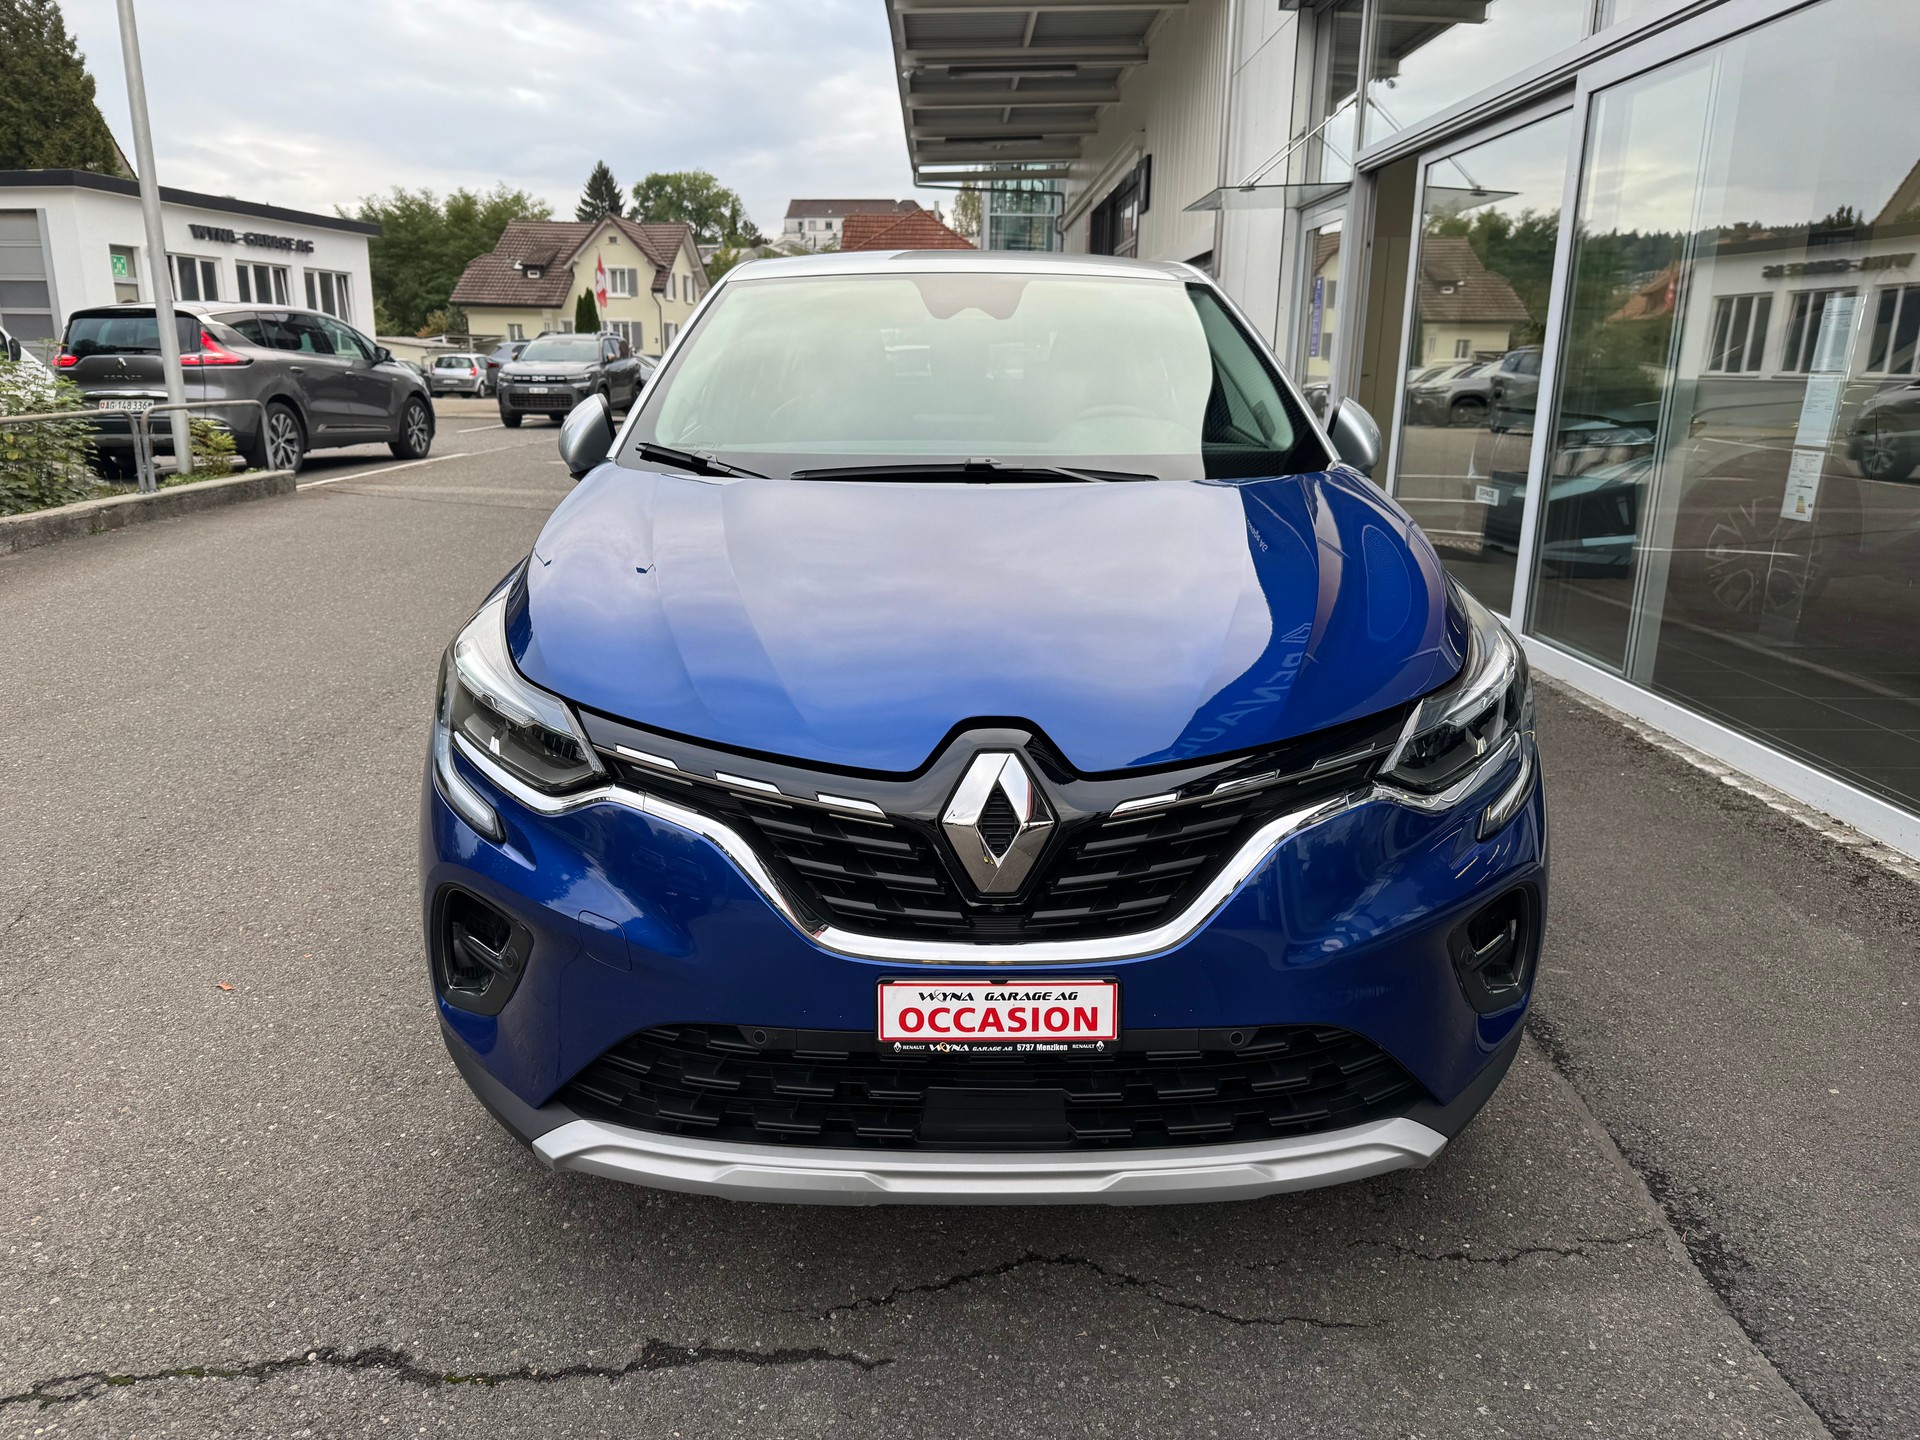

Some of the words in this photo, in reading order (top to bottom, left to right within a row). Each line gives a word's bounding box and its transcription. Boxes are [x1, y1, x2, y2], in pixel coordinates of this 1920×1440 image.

[918, 989, 975, 1002] WYNA
[984, 991, 1053, 1002] GARAGE
[1054, 991, 1079, 1001] AG
[898, 1006, 1098, 1033] OCCASION
[929, 1042, 970, 1052] WYNA
[1016, 1043, 1035, 1052] 5737
[1036, 1043, 1069, 1052] Menziken
